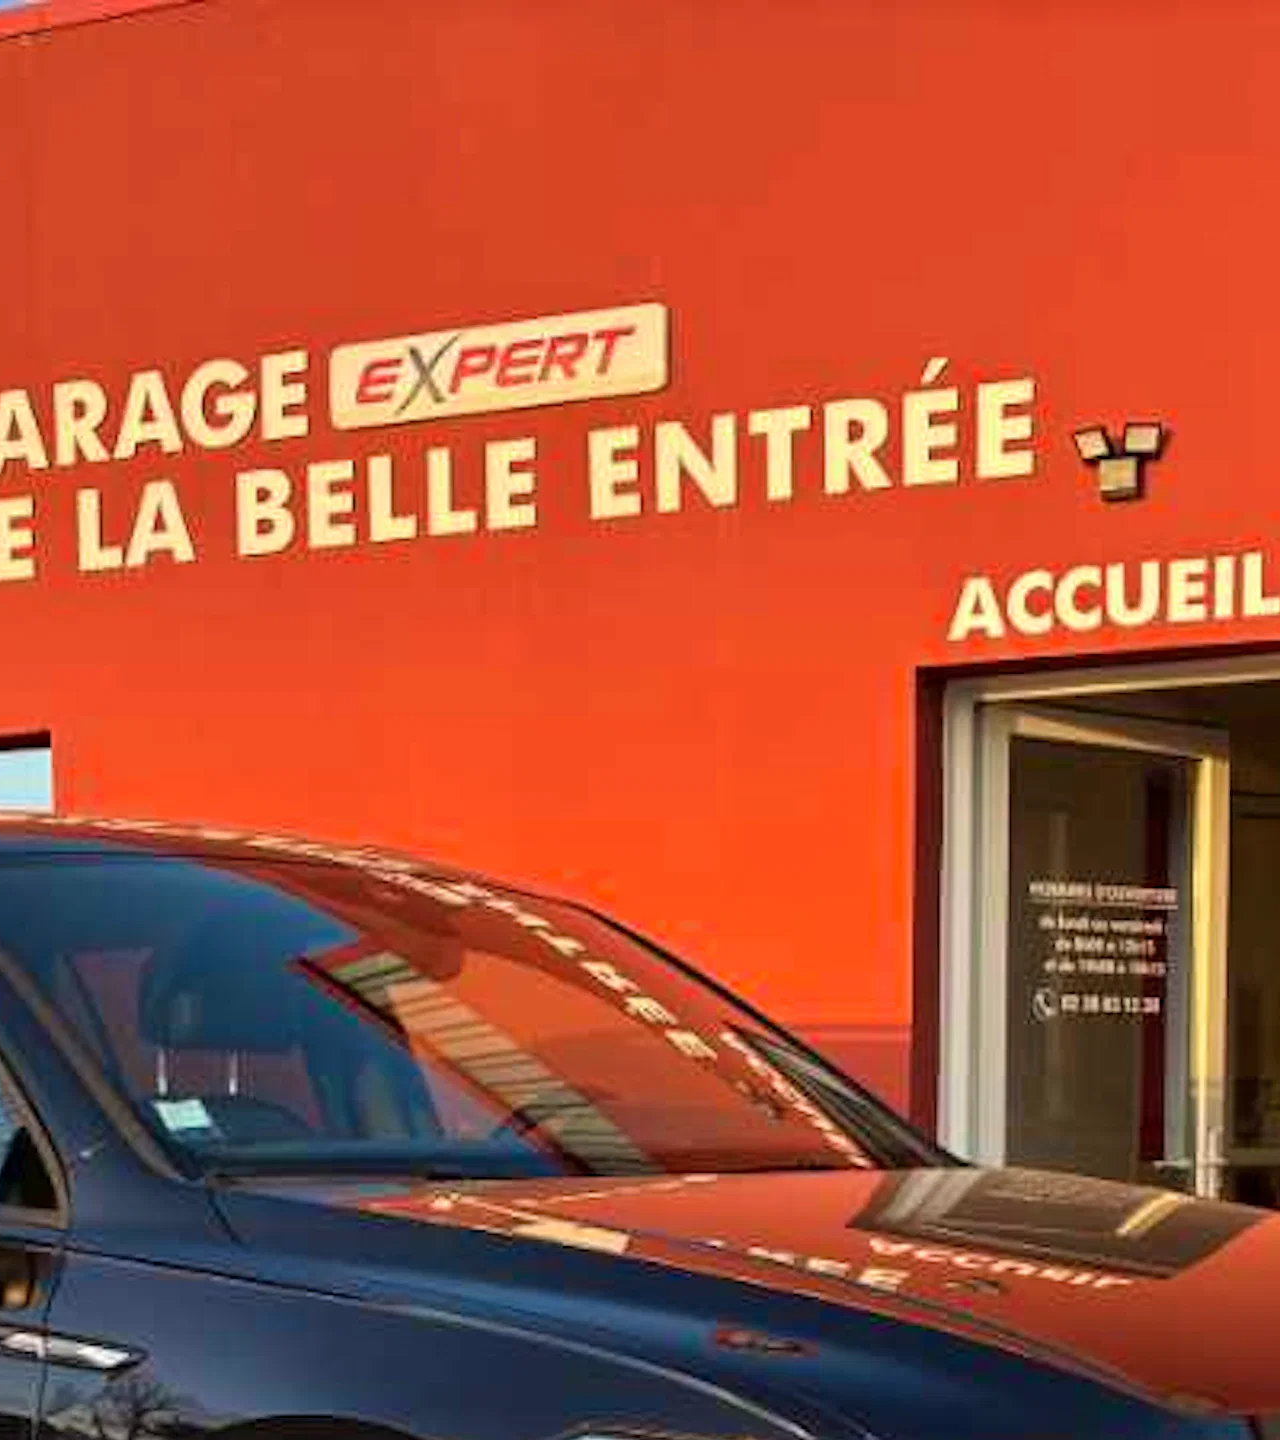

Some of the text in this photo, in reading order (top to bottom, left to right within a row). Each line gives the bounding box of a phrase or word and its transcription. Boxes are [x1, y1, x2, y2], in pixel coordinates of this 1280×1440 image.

[355, 325, 636, 416] EXPERT
[77, 479, 196, 572] LA
[236, 437, 537, 556] BELLE
[588, 358, 1036, 520] ENTRÉE
